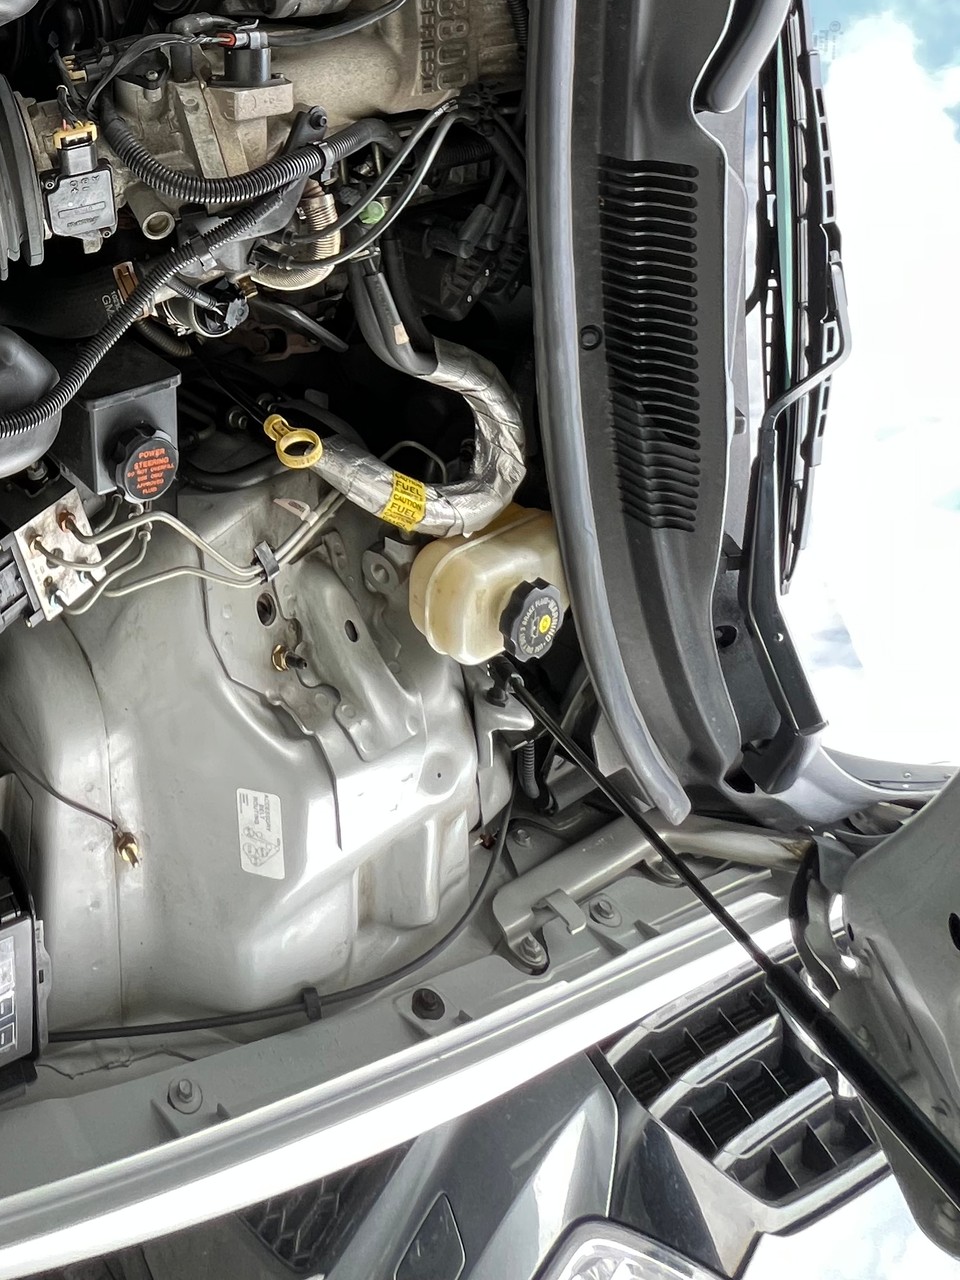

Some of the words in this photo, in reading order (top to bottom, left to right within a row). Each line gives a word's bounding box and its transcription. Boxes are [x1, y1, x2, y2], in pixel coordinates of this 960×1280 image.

[139, 448, 165, 459] POWER
[134, 456, 169, 470] STEERING
[396, 480, 421, 496] FUEL
[390, 502, 417, 519] FUEL
